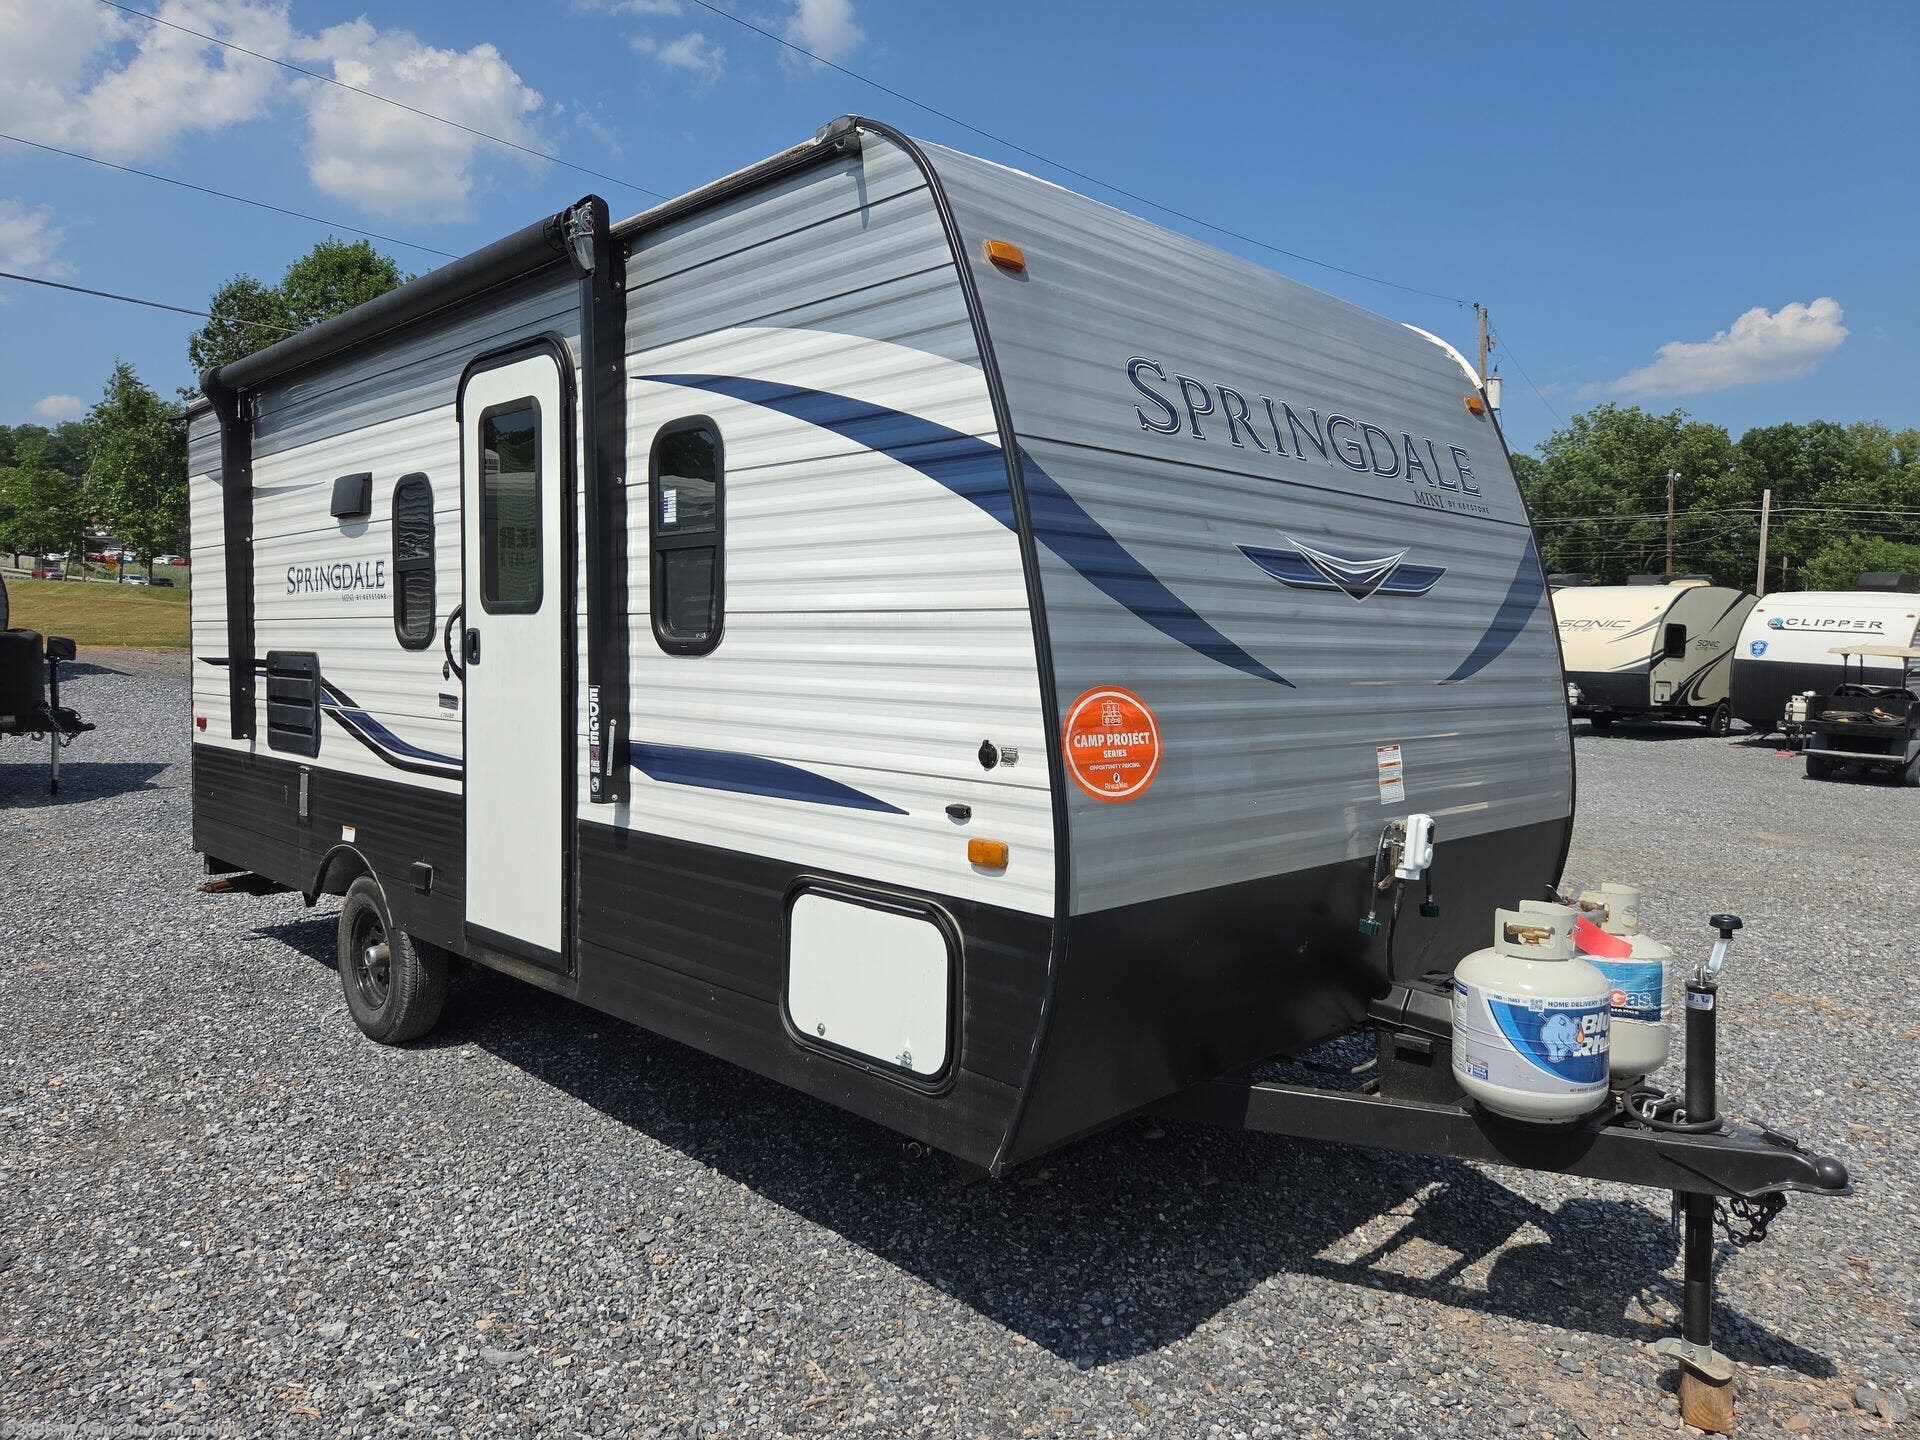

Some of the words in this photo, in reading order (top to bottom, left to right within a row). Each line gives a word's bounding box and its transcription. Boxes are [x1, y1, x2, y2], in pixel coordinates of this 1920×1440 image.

[1125, 355, 1482, 497] SPRINGDALE
[1413, 490, 1445, 508] MINI
[1447, 500, 1456, 508] BY
[1458, 502, 1490, 515] KEYSTONE
[287, 561, 385, 595] SPRINGDALE
[1557, 619, 1631, 628] SONIC
[1786, 618, 1883, 629] CLIPPER
[1696, 639, 1721, 648] SONIC
[1073, 734, 1105, 748] CAMP
[1106, 732, 1151, 746] PROJECT
[1103, 749, 1128, 758] SERIES
[1089, 763, 1121, 771] OPPORTUNITY
[1547, 1000, 1569, 1008] HOME
[1570, 999, 1599, 1008] DELIVERY
